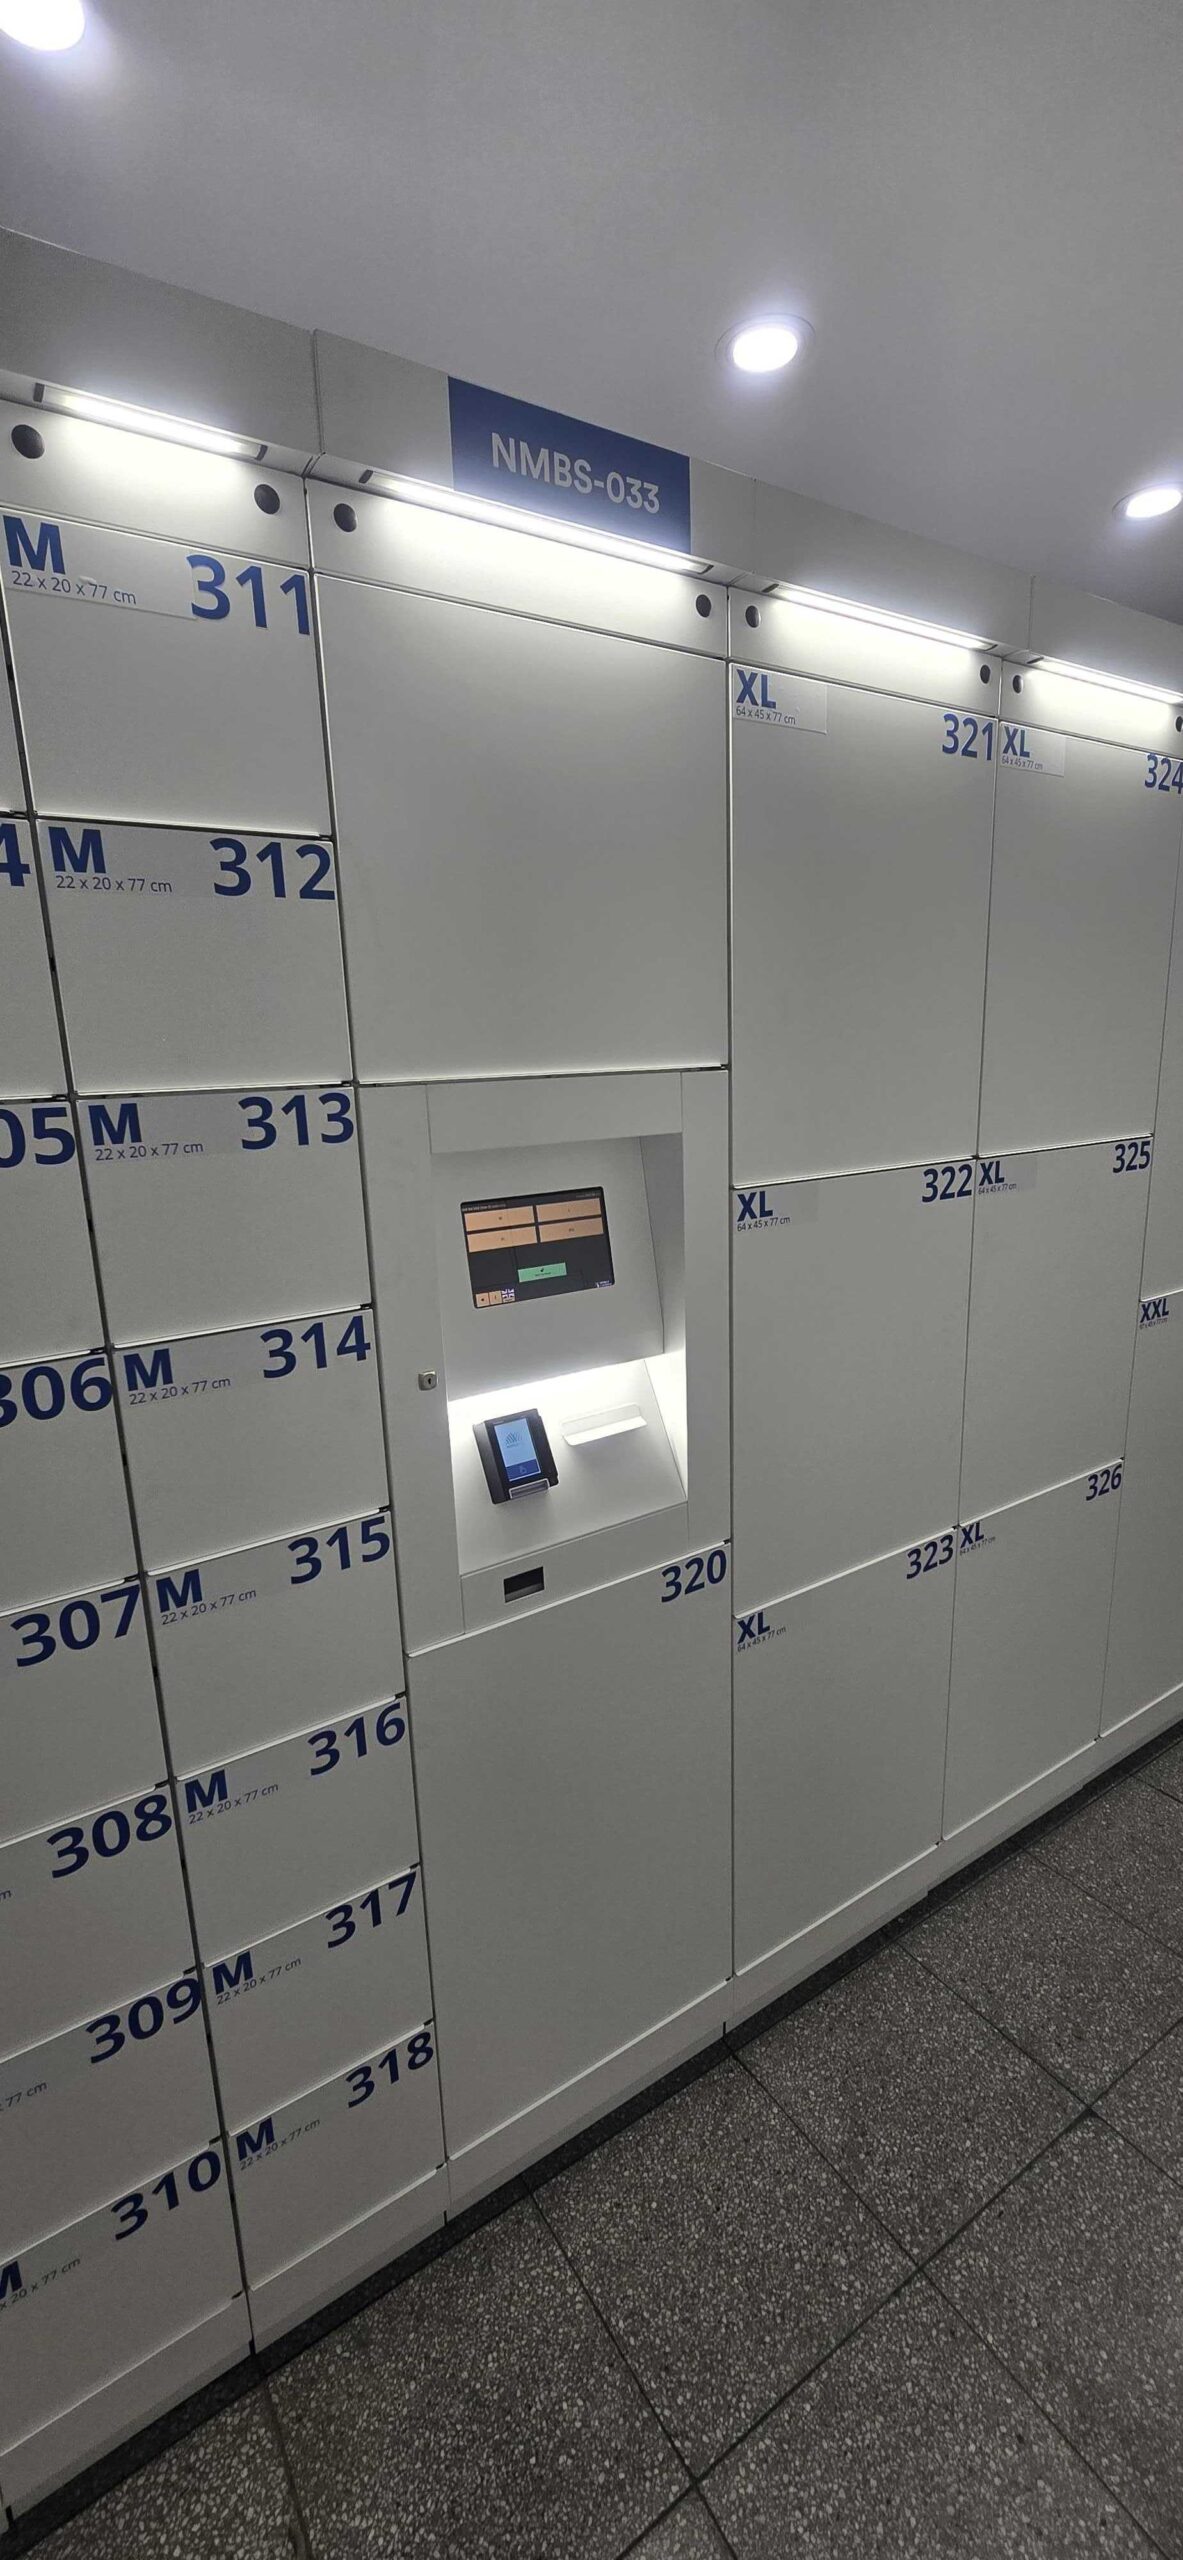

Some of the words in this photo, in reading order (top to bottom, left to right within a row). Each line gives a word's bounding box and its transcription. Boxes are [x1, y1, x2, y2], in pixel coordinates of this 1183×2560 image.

[491, 432, 660, 514] NMBS-033
[3, 515, 66, 575] M
[11, 570, 34, 587] 22
[37, 577, 47, 590] x
[51, 577, 71, 593] 20
[76, 583, 86, 596] x
[88, 582, 108, 599] 77
[113, 590, 137, 605] cm
[186, 554, 311, 635] 311
[736, 669, 776, 709] XL
[736, 706, 746, 716] 64
[754, 708, 764, 719] 45
[766, 712, 771, 720] x
[773, 711, 782, 722] 77
[784, 715, 796, 725] cm
[942, 713, 993, 761] 321
[1003, 726, 1030, 758] XL
[1145, 753, 1183, 794] 324
[48, 826, 106, 874] M
[209, 837, 336, 900] 312
[56, 876, 75, 889] 22
[79, 879, 89, 890] x
[93, 877, 111, 890] 20
[116, 880, 125, 891] x
[128, 878, 145, 892] 77
[150, 881, 173, 893] cm
[88, 1103, 142, 1145] M
[238, 1092, 354, 1150] 313
[95, 1149, 113, 1161] 22
[117, 1151, 126, 1159] x
[130, 1146, 147, 1158] 20
[150, 1148, 159, 1156] x
[162, 1143, 178, 1155] 77
[183, 1143, 204, 1153] cm
[979, 1161, 1005, 1186] XL
[1113, 1140, 1151, 1173] 325
[922, 1164, 972, 1203] 322
[737, 1191, 773, 1222] XL
[737, 1223, 746, 1232] 64
[754, 1220, 763, 1228] 45
[770, 1217, 778, 1226] 77
[1140, 1298, 1169, 1323] XXL
[260, 1315, 371, 1379] 314
[124, 1348, 173, 1391] M
[129, 1393, 146, 1405] 22
[150, 1393, 158, 1402] x
[161, 1387, 178, 1399] 20
[181, 1386, 189, 1394] x
[194, 1380, 208, 1392] 77
[212, 1378, 231, 1389] cm
[1086, 1463, 1122, 1501] 326
[288, 1516, 390, 1584] 315
[906, 1534, 954, 1579] 323
[961, 1522, 984, 1548] XL
[156, 1569, 203, 1613] M
[661, 1549, 727, 1602] 320
[10, 1584, 140, 1667] 307
[161, 1613, 178, 1625] 22
[180, 1611, 188, 1620] x
[191, 1604, 206, 1616] 20
[210, 1602, 218, 1610] x
[220, 1594, 235, 1607] 77
[238, 1589, 256, 1601] cm
[737, 1612, 770, 1644] XL
[307, 1702, 405, 1776] 316
[184, 1769, 228, 1813] M
[189, 1812, 204, 1824] 22
[206, 1809, 214, 1818] x
[217, 1800, 232, 1814] 20
[234, 1798, 242, 1807] x
[244, 1789, 258, 1802] 77
[261, 1784, 279, 1796] cm
[46, 1794, 173, 1878] 308
[325, 1872, 417, 1948] 317
[212, 1951, 253, 1995] M
[216, 1992, 231, 2005] 22
[234, 1988, 241, 1997] x
[243, 1979, 257, 1992] 20
[259, 1976, 266, 1984] x
[268, 1966, 282, 1980] 77
[285, 1958, 302, 1972] cm
[85, 1978, 201, 2064] 309
[345, 2031, 434, 2108] 318
[5, 2092, 22, 2107] 77
[26, 2082, 48, 2096] cm
[236, 2116, 275, 2161] M
[240, 2156, 254, 2171] 22
[256, 2152, 262, 2160] x
[265, 2143, 278, 2156] 20
[280, 2138, 287, 2146] x
[289, 2128, 302, 2141] 77
[304, 2119, 320, 2132] cm
[110, 2150, 222, 2241] 310
[10, 2288, 28, 2304] 20
[31, 2282, 39, 2292] x
[42, 2268, 57, 2285] 77
[62, 2258, 80, 2273] cm
